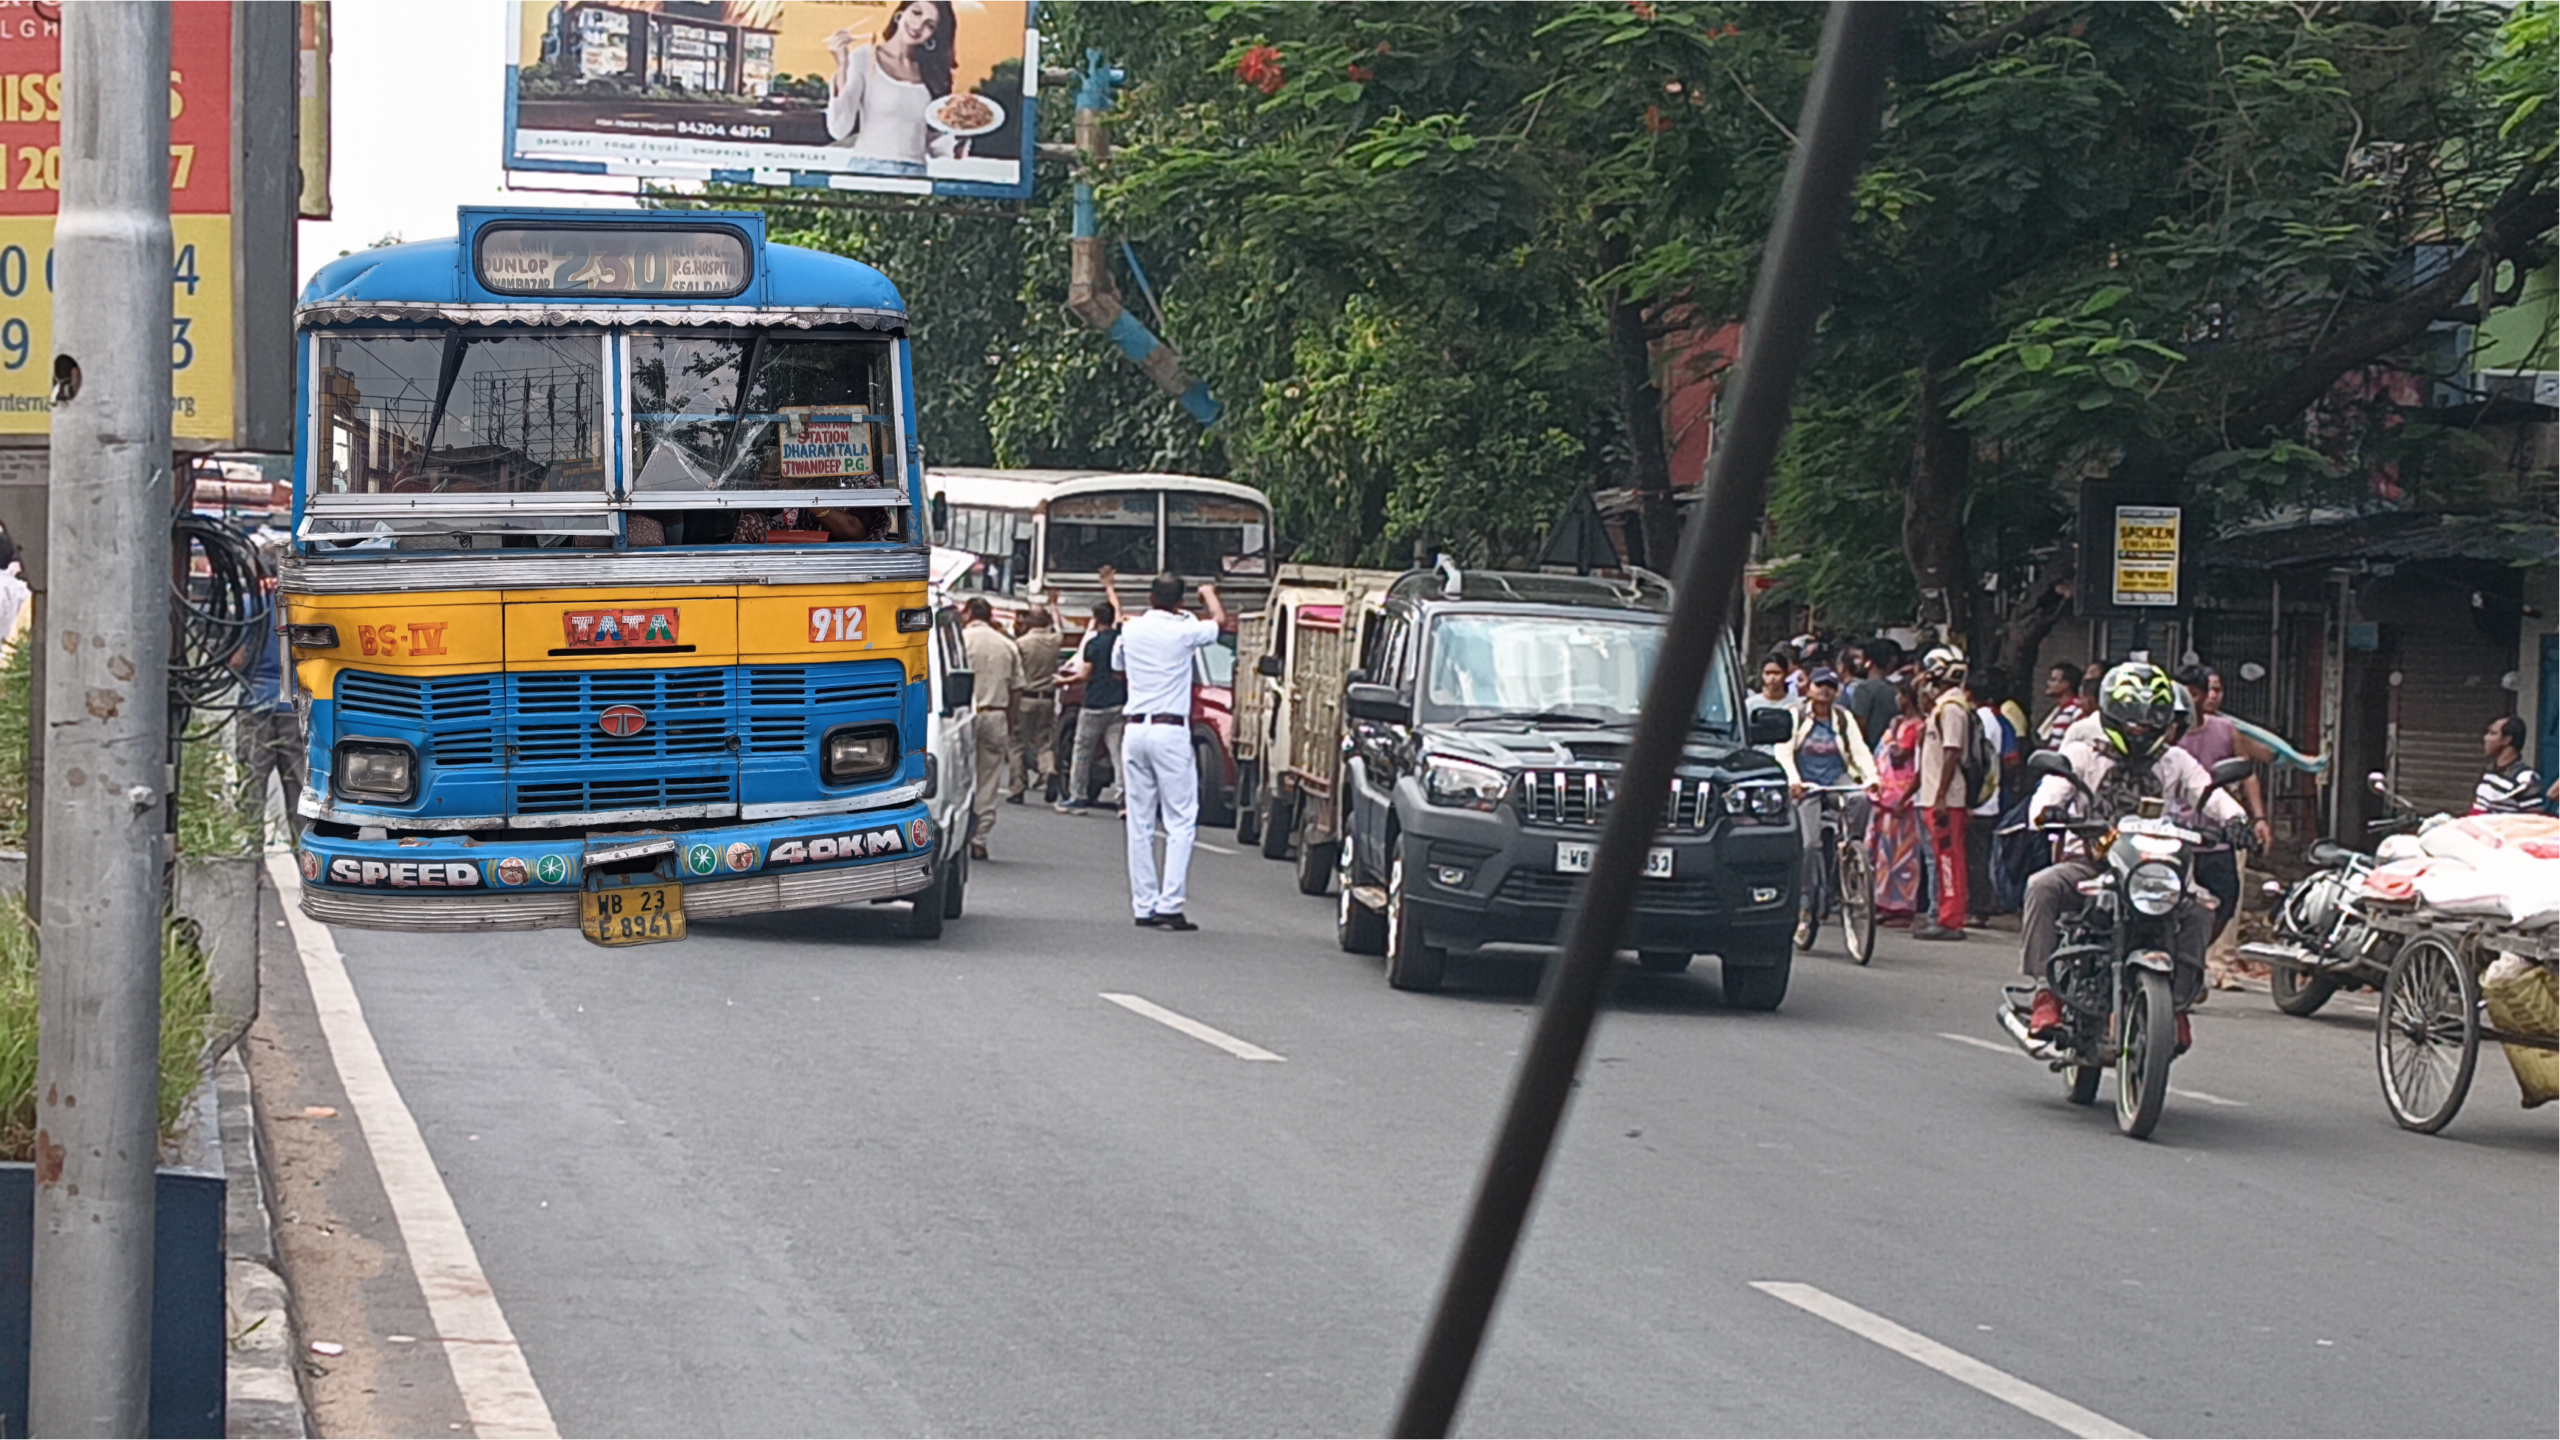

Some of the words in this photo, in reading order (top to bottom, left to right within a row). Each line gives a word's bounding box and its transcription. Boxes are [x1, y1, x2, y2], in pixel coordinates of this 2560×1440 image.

[678, 121, 726, 136] 84204
[484, 257, 549, 274] DUNLOP
[553, 236, 668, 291] 230
[783, 443, 869, 458] DHARAMTALA
[797, 431, 849, 444] STATION
[782, 460, 842, 475] JIWANDEEP
[572, 614, 672, 641] TATA
[812, 607, 863, 642] 912
[358, 621, 448, 657] BS-IV
[770, 828, 903, 864] 40KM
[331, 858, 479, 887] SPEED
[597, 893, 622, 915] WB
[640, 889, 665, 911] 23
